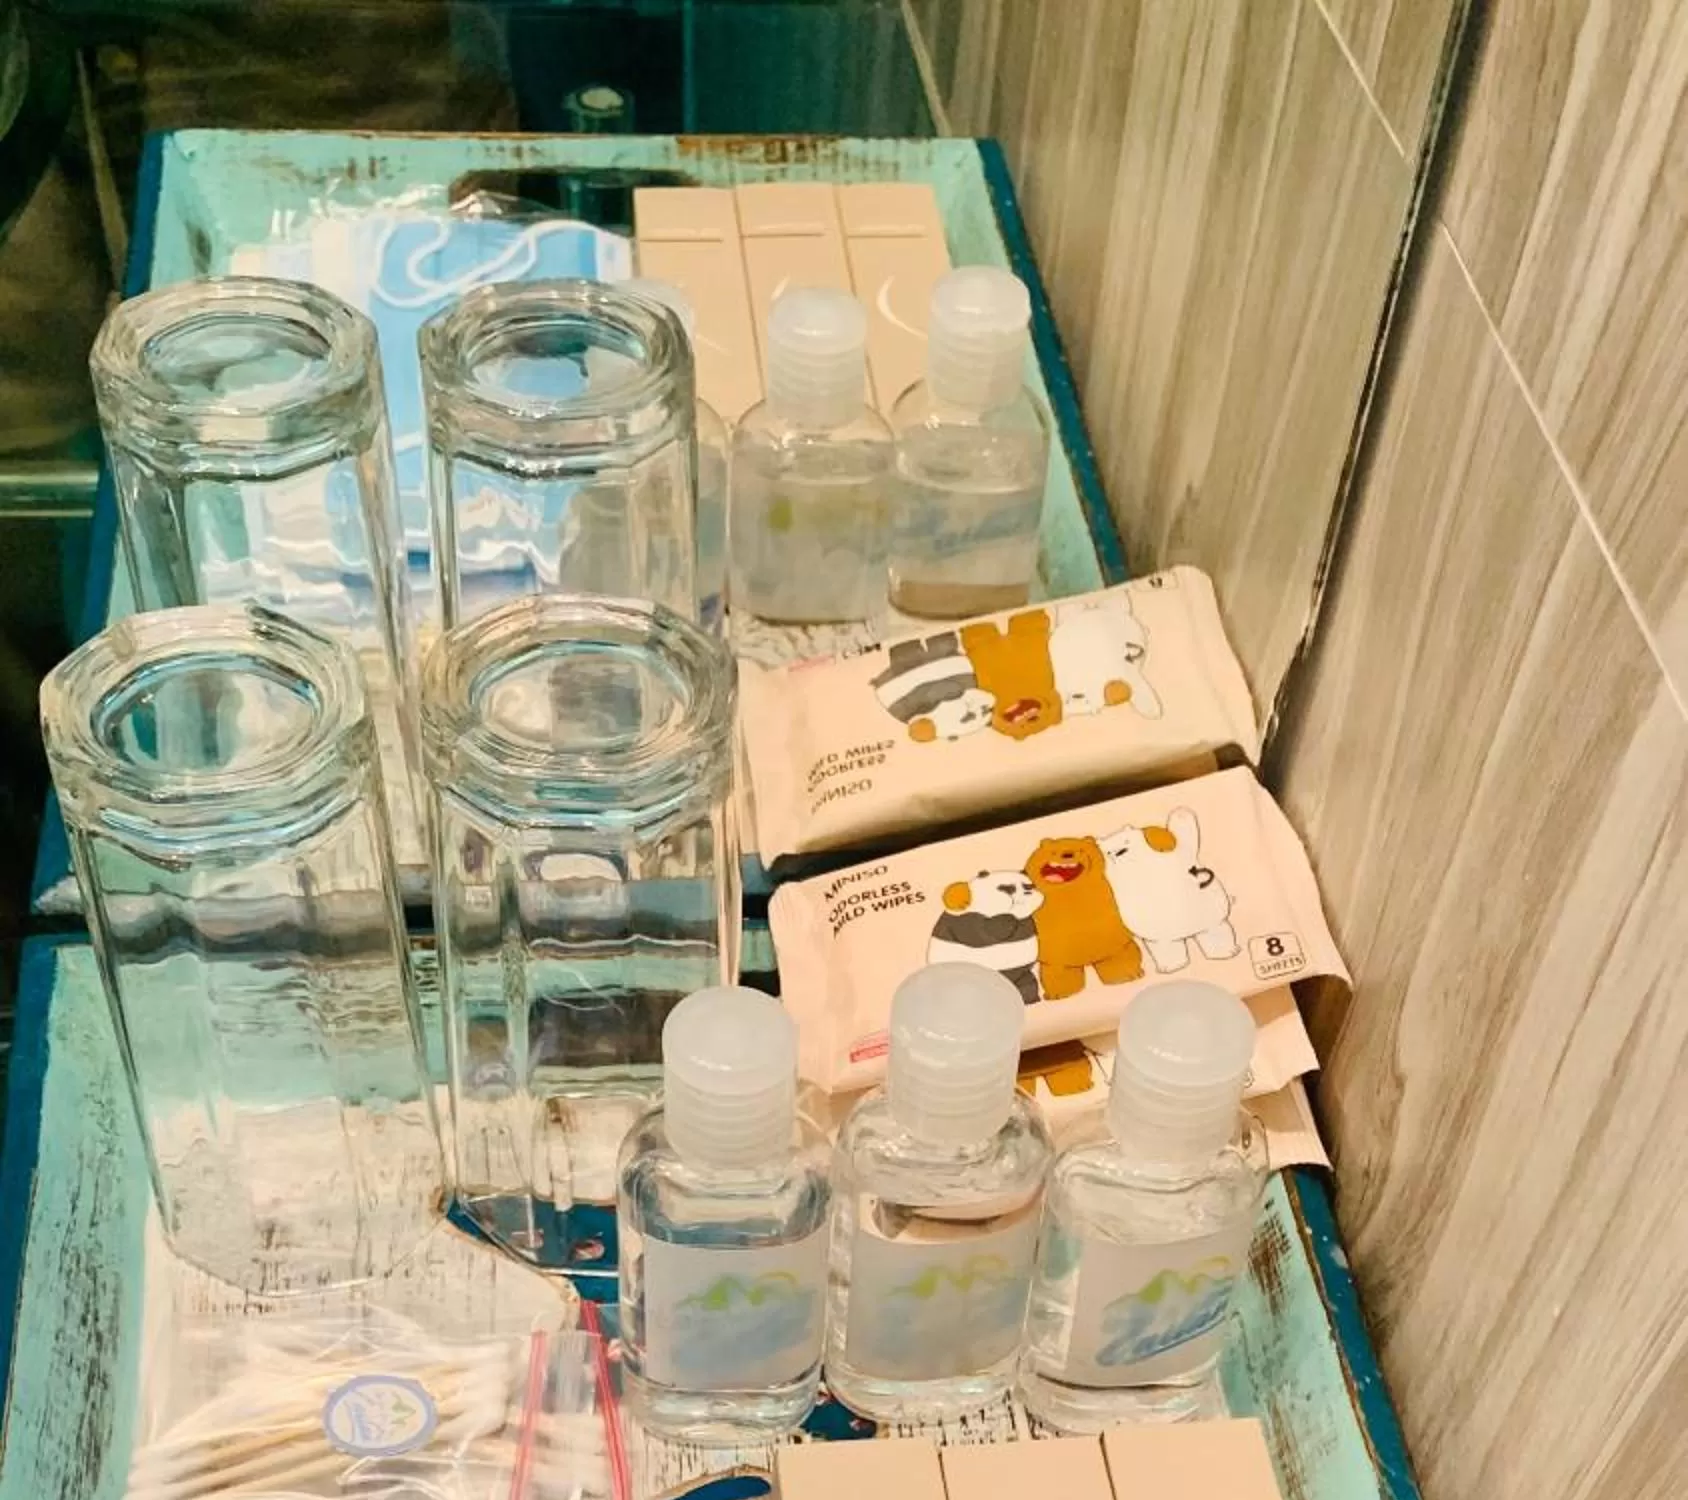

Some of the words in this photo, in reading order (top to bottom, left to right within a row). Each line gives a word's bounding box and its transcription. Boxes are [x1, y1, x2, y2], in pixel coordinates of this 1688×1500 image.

[824, 865, 889, 903] MINISO
[828, 881, 912, 924] ODORLESS
[871, 891, 926, 912] WIPES
[1265, 937, 1285, 957] 8
